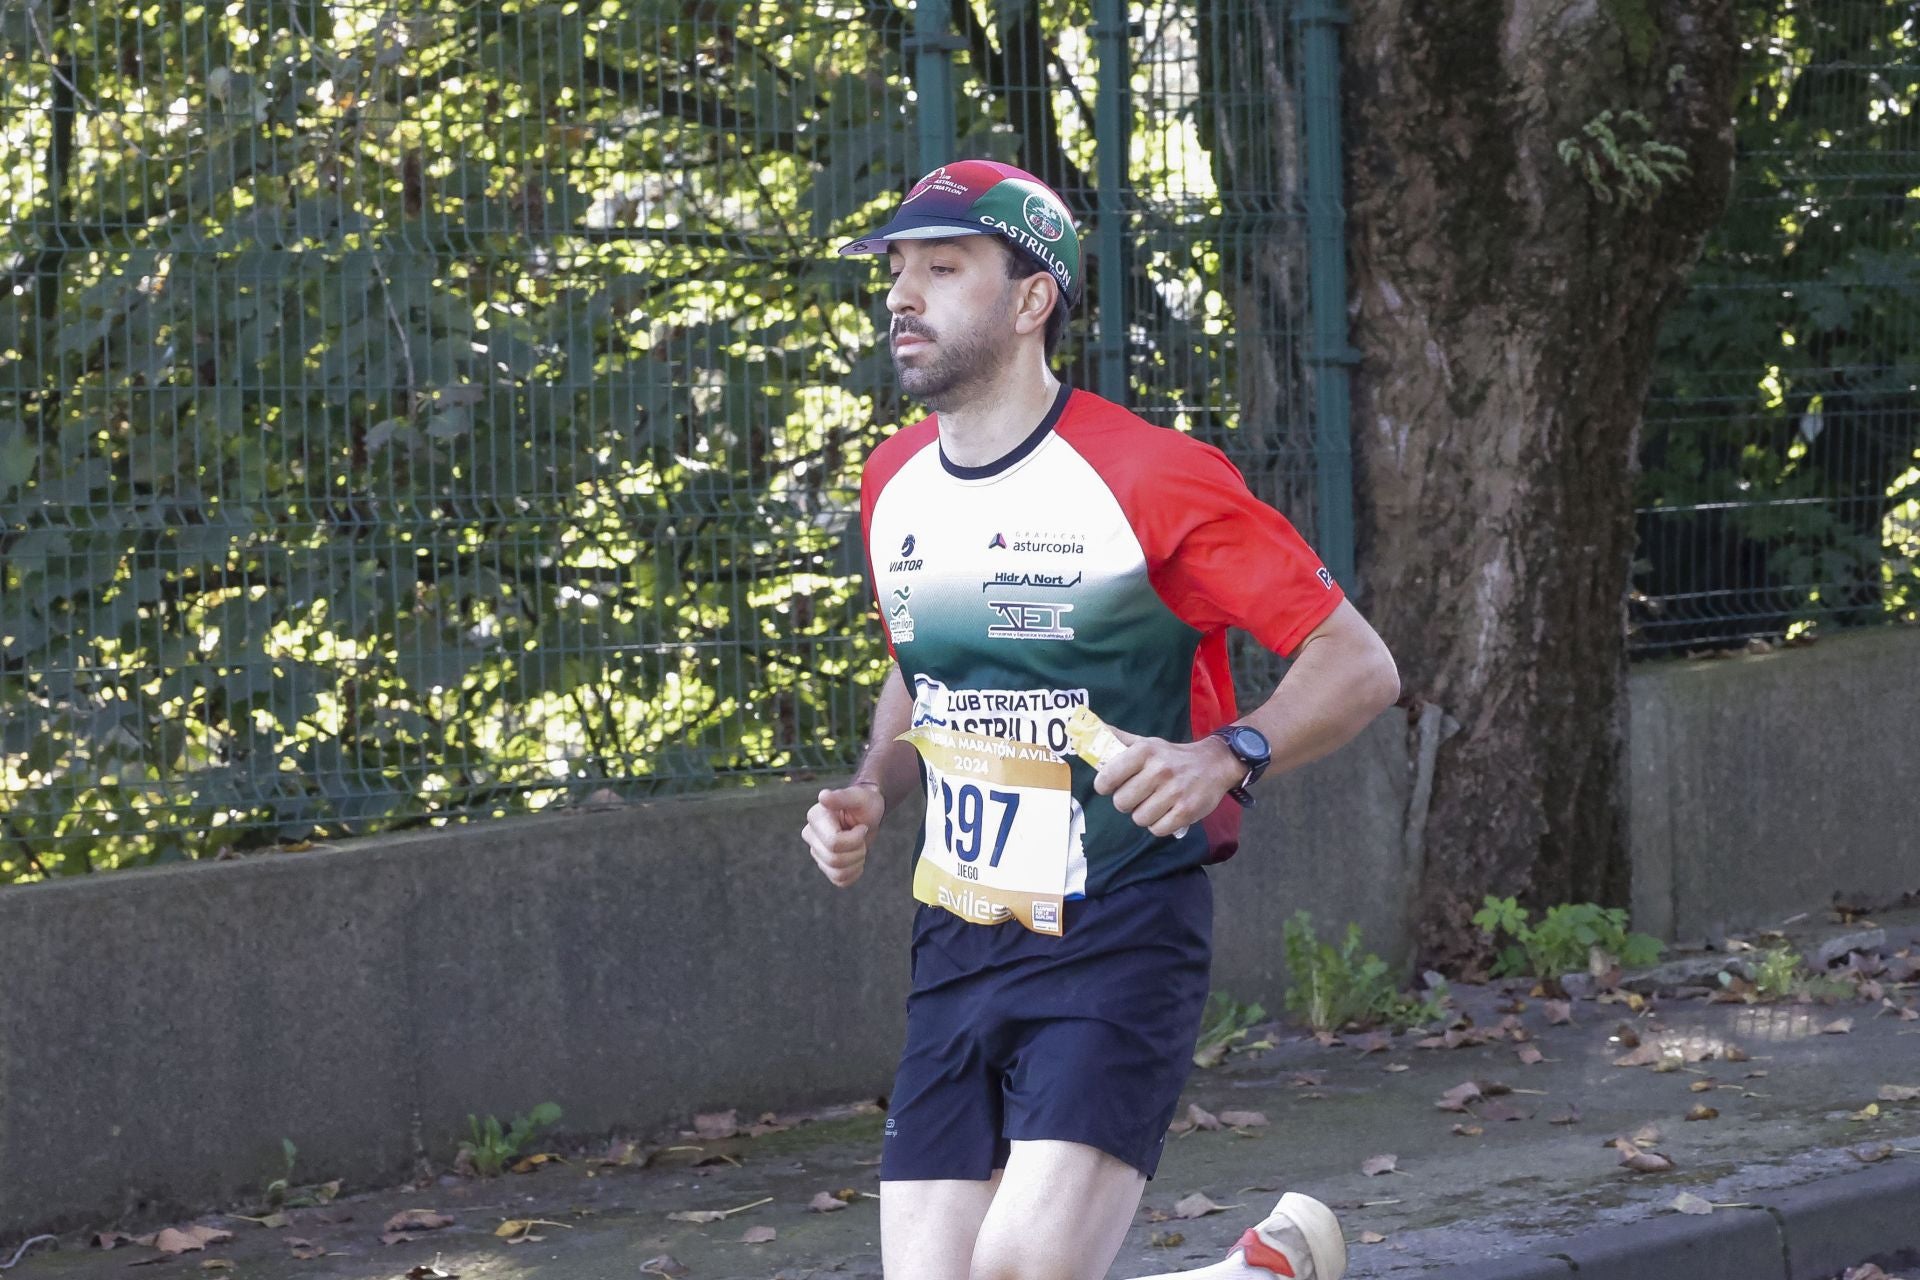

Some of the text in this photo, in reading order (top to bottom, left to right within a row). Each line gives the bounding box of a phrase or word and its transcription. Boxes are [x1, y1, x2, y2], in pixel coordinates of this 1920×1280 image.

[979, 215, 1072, 287] CASTRILLON
[889, 559, 923, 572] VIATOR
[947, 693, 1084, 712] LUB TRIATLON
[953, 756, 989, 775] 2024
[939, 886, 1012, 920] avilés
